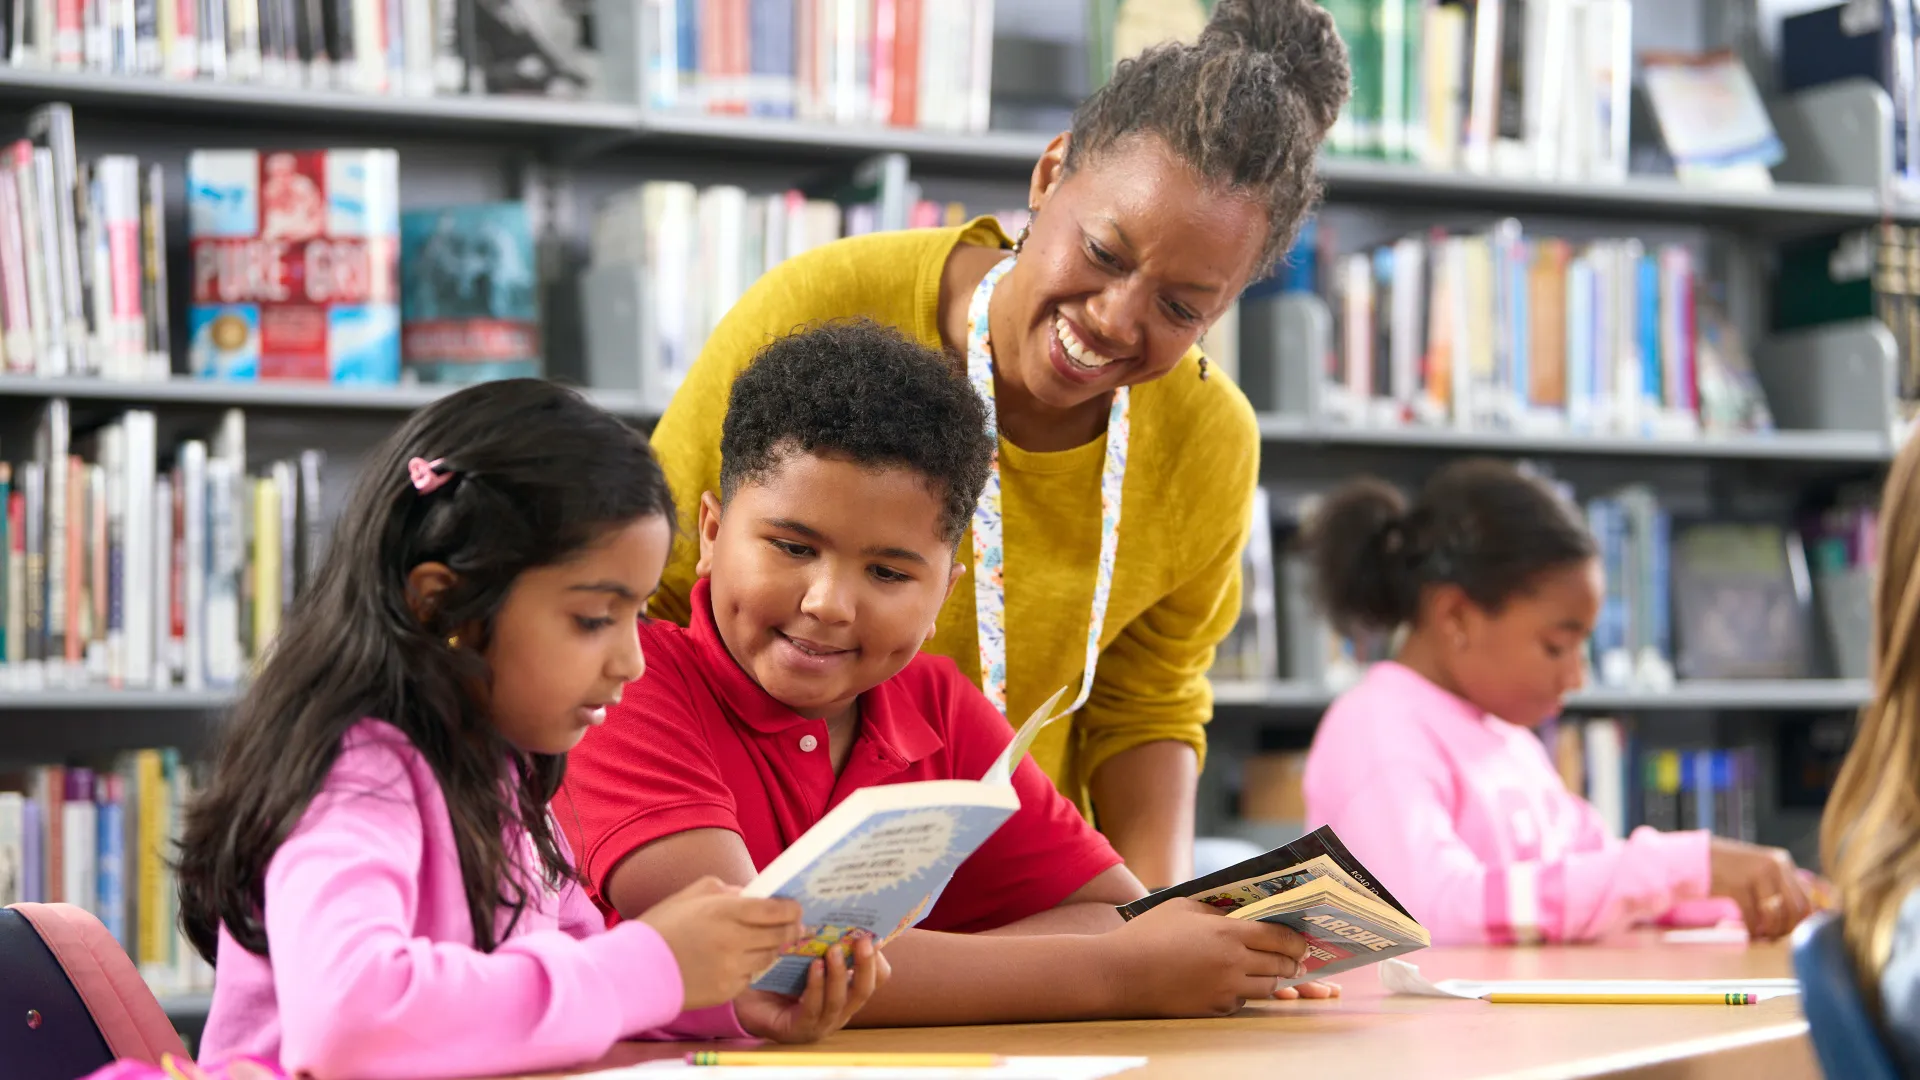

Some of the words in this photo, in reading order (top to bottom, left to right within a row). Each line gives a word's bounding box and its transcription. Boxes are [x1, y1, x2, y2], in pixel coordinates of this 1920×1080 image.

[194, 239, 289, 302] PURE
[1351, 870, 1370, 887] ROAD
[1301, 914, 1399, 952] ARCHIE
[1306, 943, 1337, 962] CHIE
